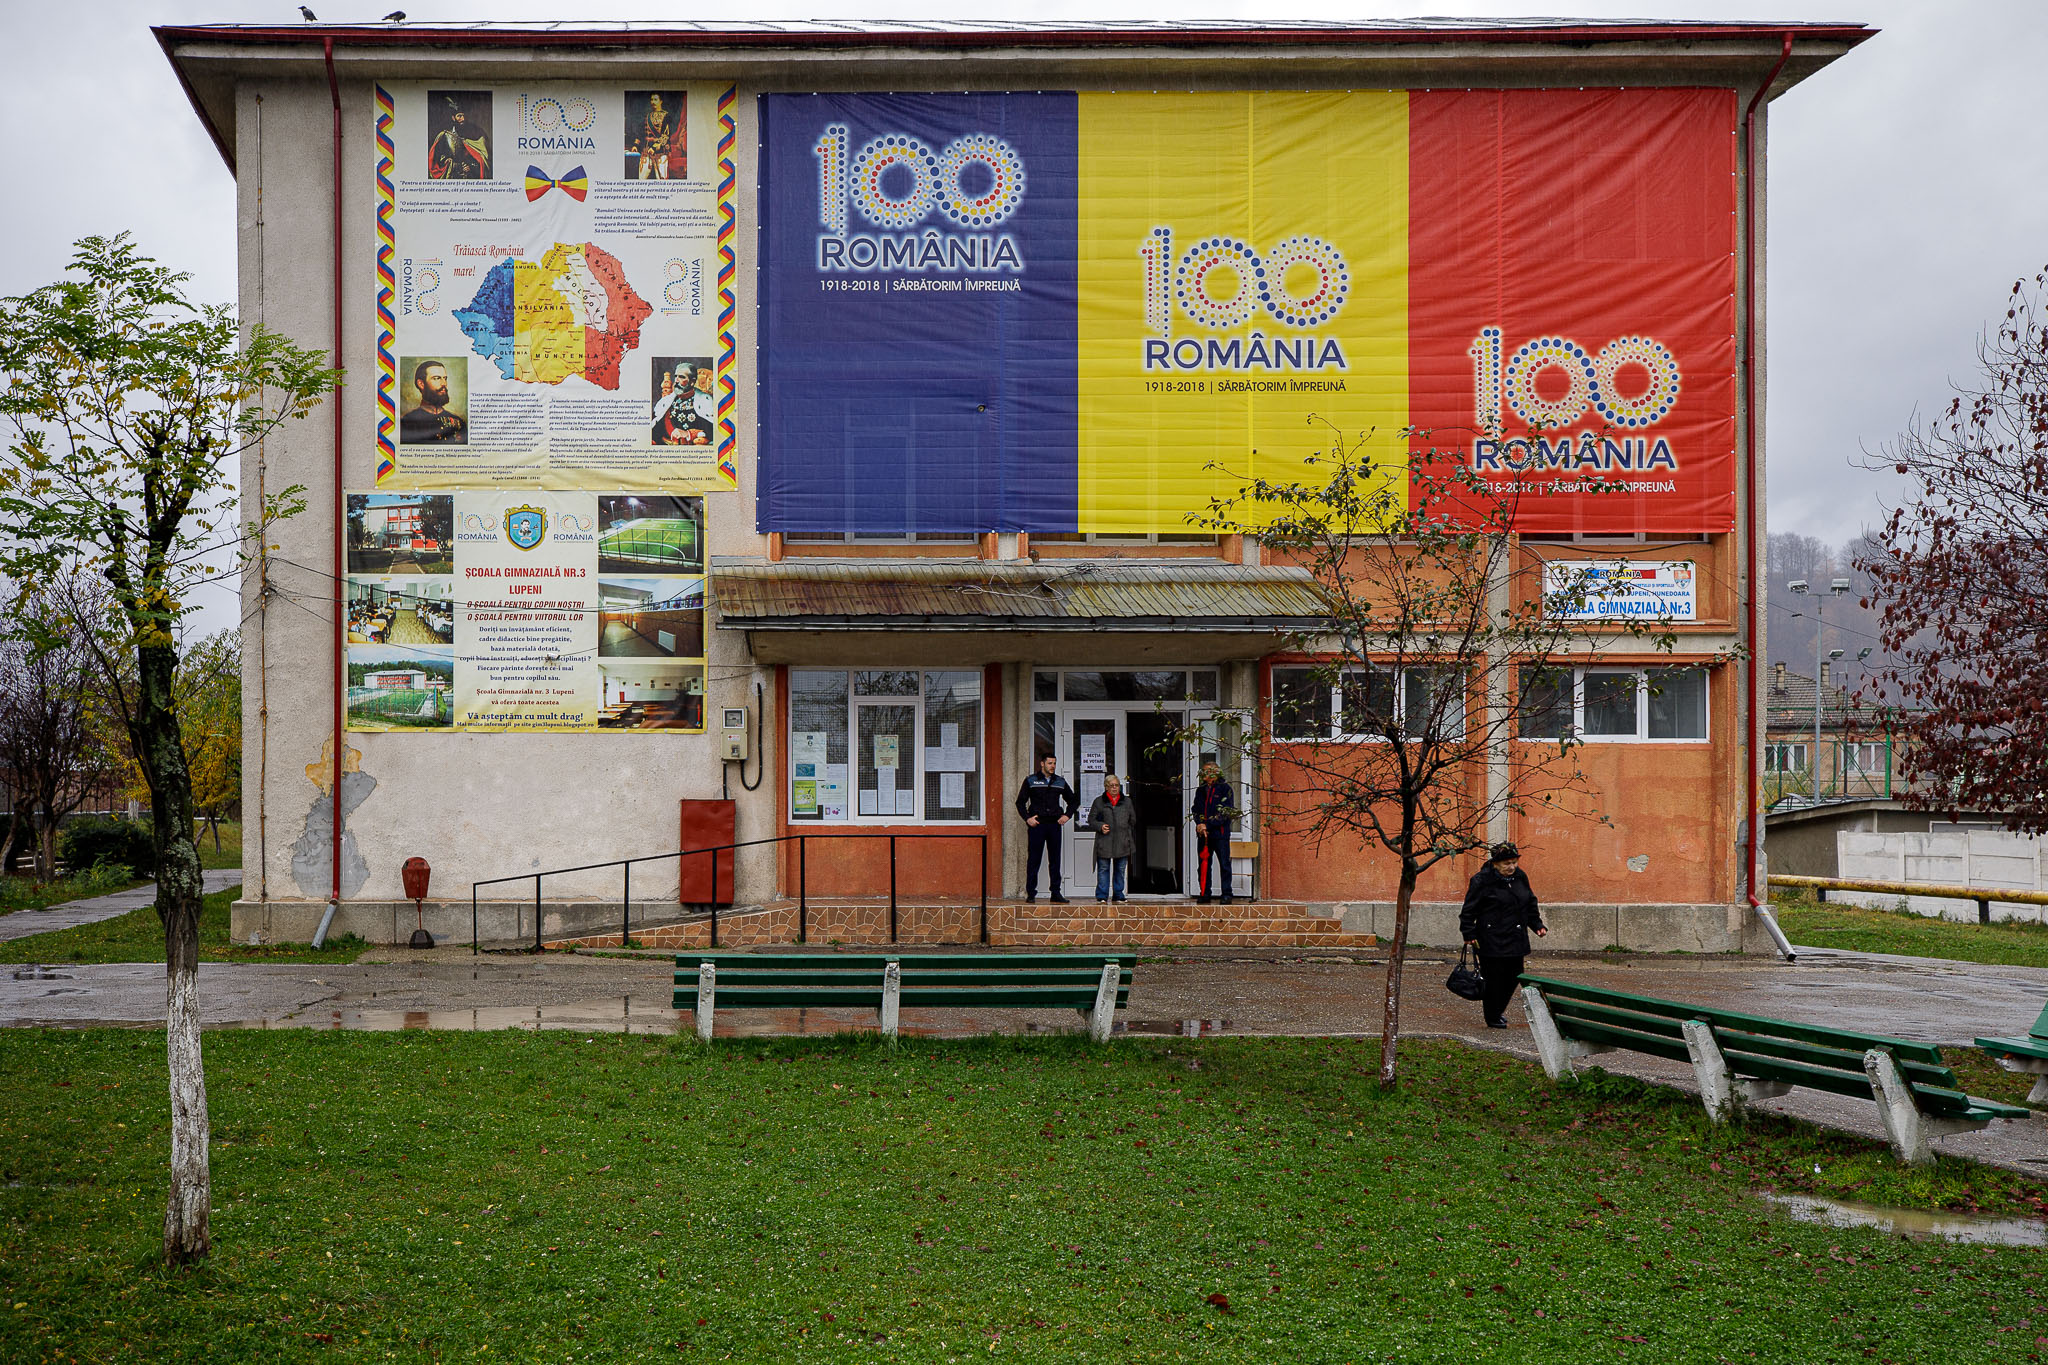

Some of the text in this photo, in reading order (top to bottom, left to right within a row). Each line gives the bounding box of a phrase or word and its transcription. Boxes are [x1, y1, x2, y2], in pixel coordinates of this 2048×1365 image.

[516, 93, 596, 137] 100
[518, 134, 595, 149] ROMÂNIA
[815, 126, 1023, 236] 100
[454, 244, 524, 258] Trăiască România
[820, 231, 1021, 268] ROMÂNIA
[453, 265, 476, 277] mare!
[403, 258, 414, 316] ROMÂNIA
[690, 258, 701, 316] ROMÂNIA
[820, 278, 1021, 292] 1918-2018 SĂRBĂTORIM ÎMPREUNĂ
[1142, 228, 1348, 337] 100
[1146, 333, 1346, 368] ROMÂNIA
[1145, 379, 1346, 392] 1918-2018 SĂRBĂTORIM ÎMPREUNĂ
[1476, 433, 1676, 469] ROMÂNIA
[1620, 479, 1676, 493] MPREUNĂ
[457, 532, 498, 541] ROMÂNIA
[554, 532, 594, 541] ROMÂNIA
[465, 566, 586, 579] ȘCOALA GIMNAZIALĂ NR.3
[509, 585, 542, 595] LUPENI
[467, 600, 473, 608] O
[474, 600, 503, 609] ȘCOALĂ
[503, 600, 533, 608] PENTRU
[557, 600, 585, 609] NOȘTRI
[1553, 601, 1595, 614] OALA
[1670, 601, 1691, 614] Nr.3
[467, 612, 584, 622] O ȘCOALĂ PENTRU VIITORUL LOR
[476, 688, 497, 696] Școala
[552, 688, 574, 696] Lupeni
[467, 712, 479, 720] Vă
[481, 712, 522, 722] așteptăm
[536, 712, 558, 720] mult
[559, 712, 584, 722] drag!
